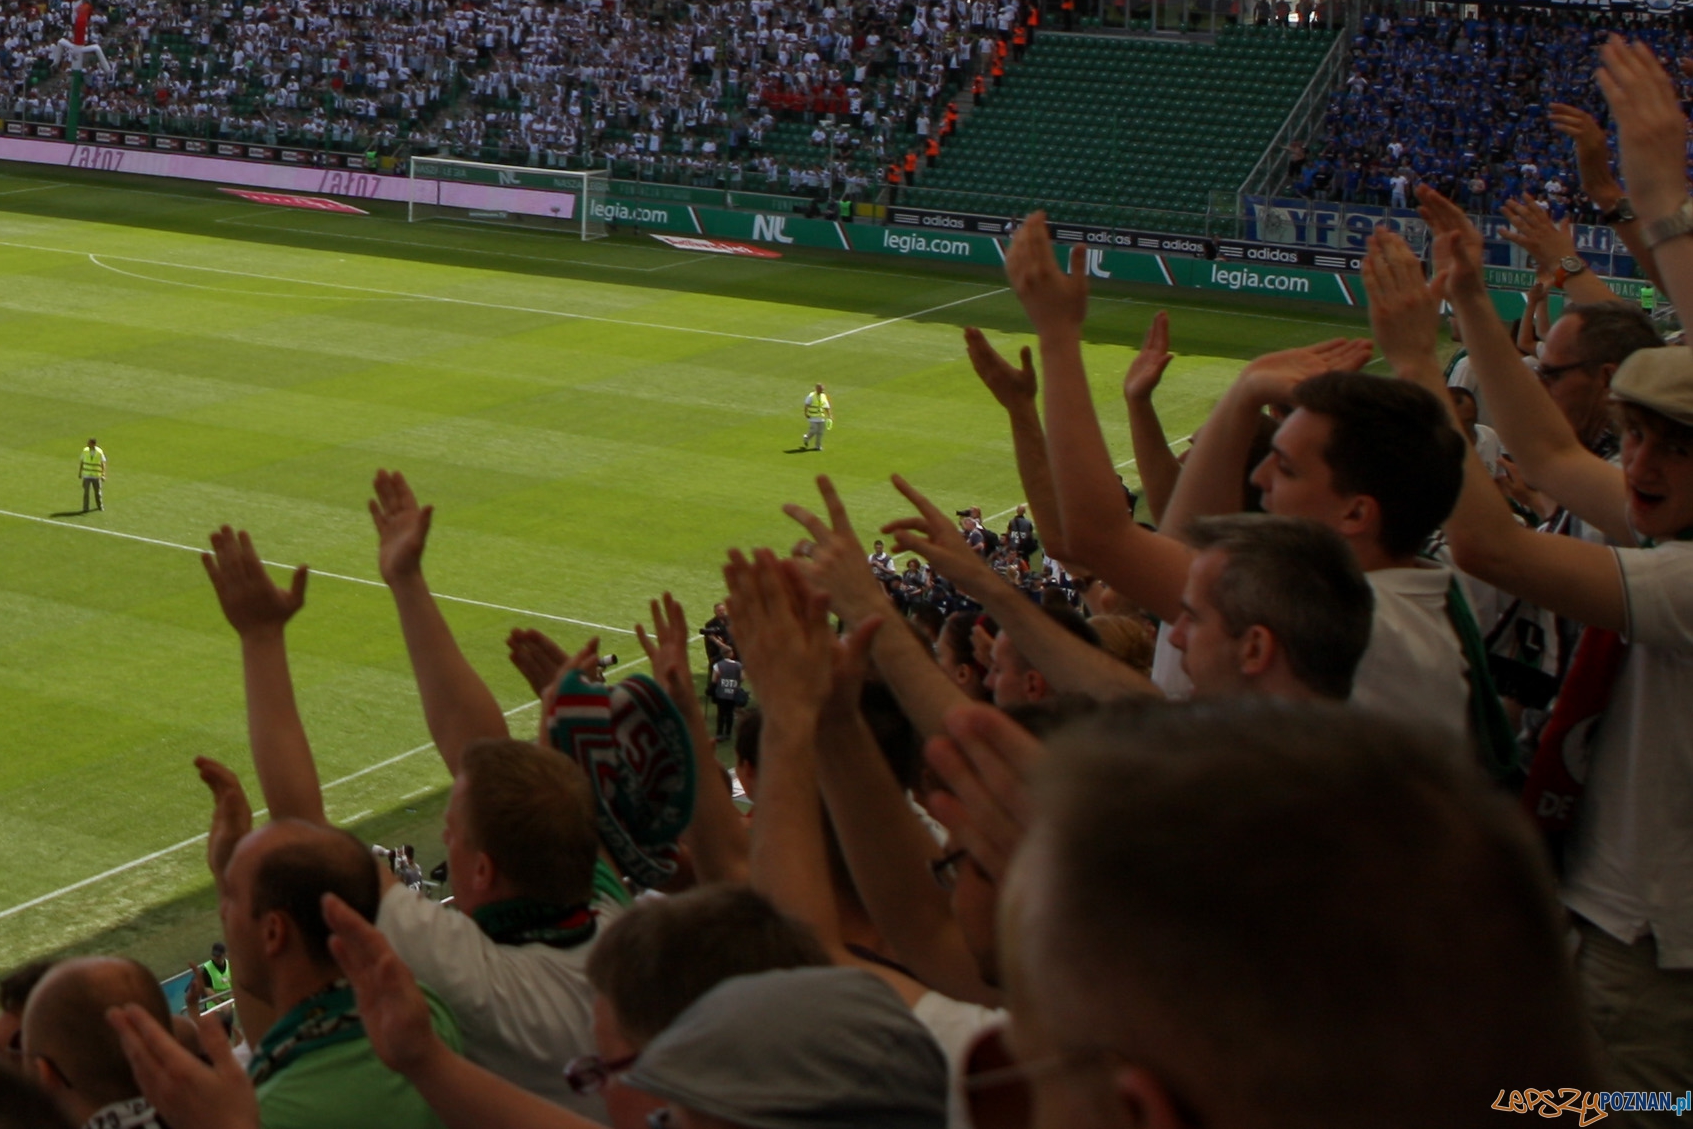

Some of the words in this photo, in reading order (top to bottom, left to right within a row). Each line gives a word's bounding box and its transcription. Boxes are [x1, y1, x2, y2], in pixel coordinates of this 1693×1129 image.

[589, 199, 668, 224] legia.com
[922, 215, 965, 229] adidas
[883, 229, 970, 256] legia.com
[1162, 240, 1204, 252] adidas
[1247, 247, 1298, 263] adidas
[1211, 264, 1310, 293] legia.com
